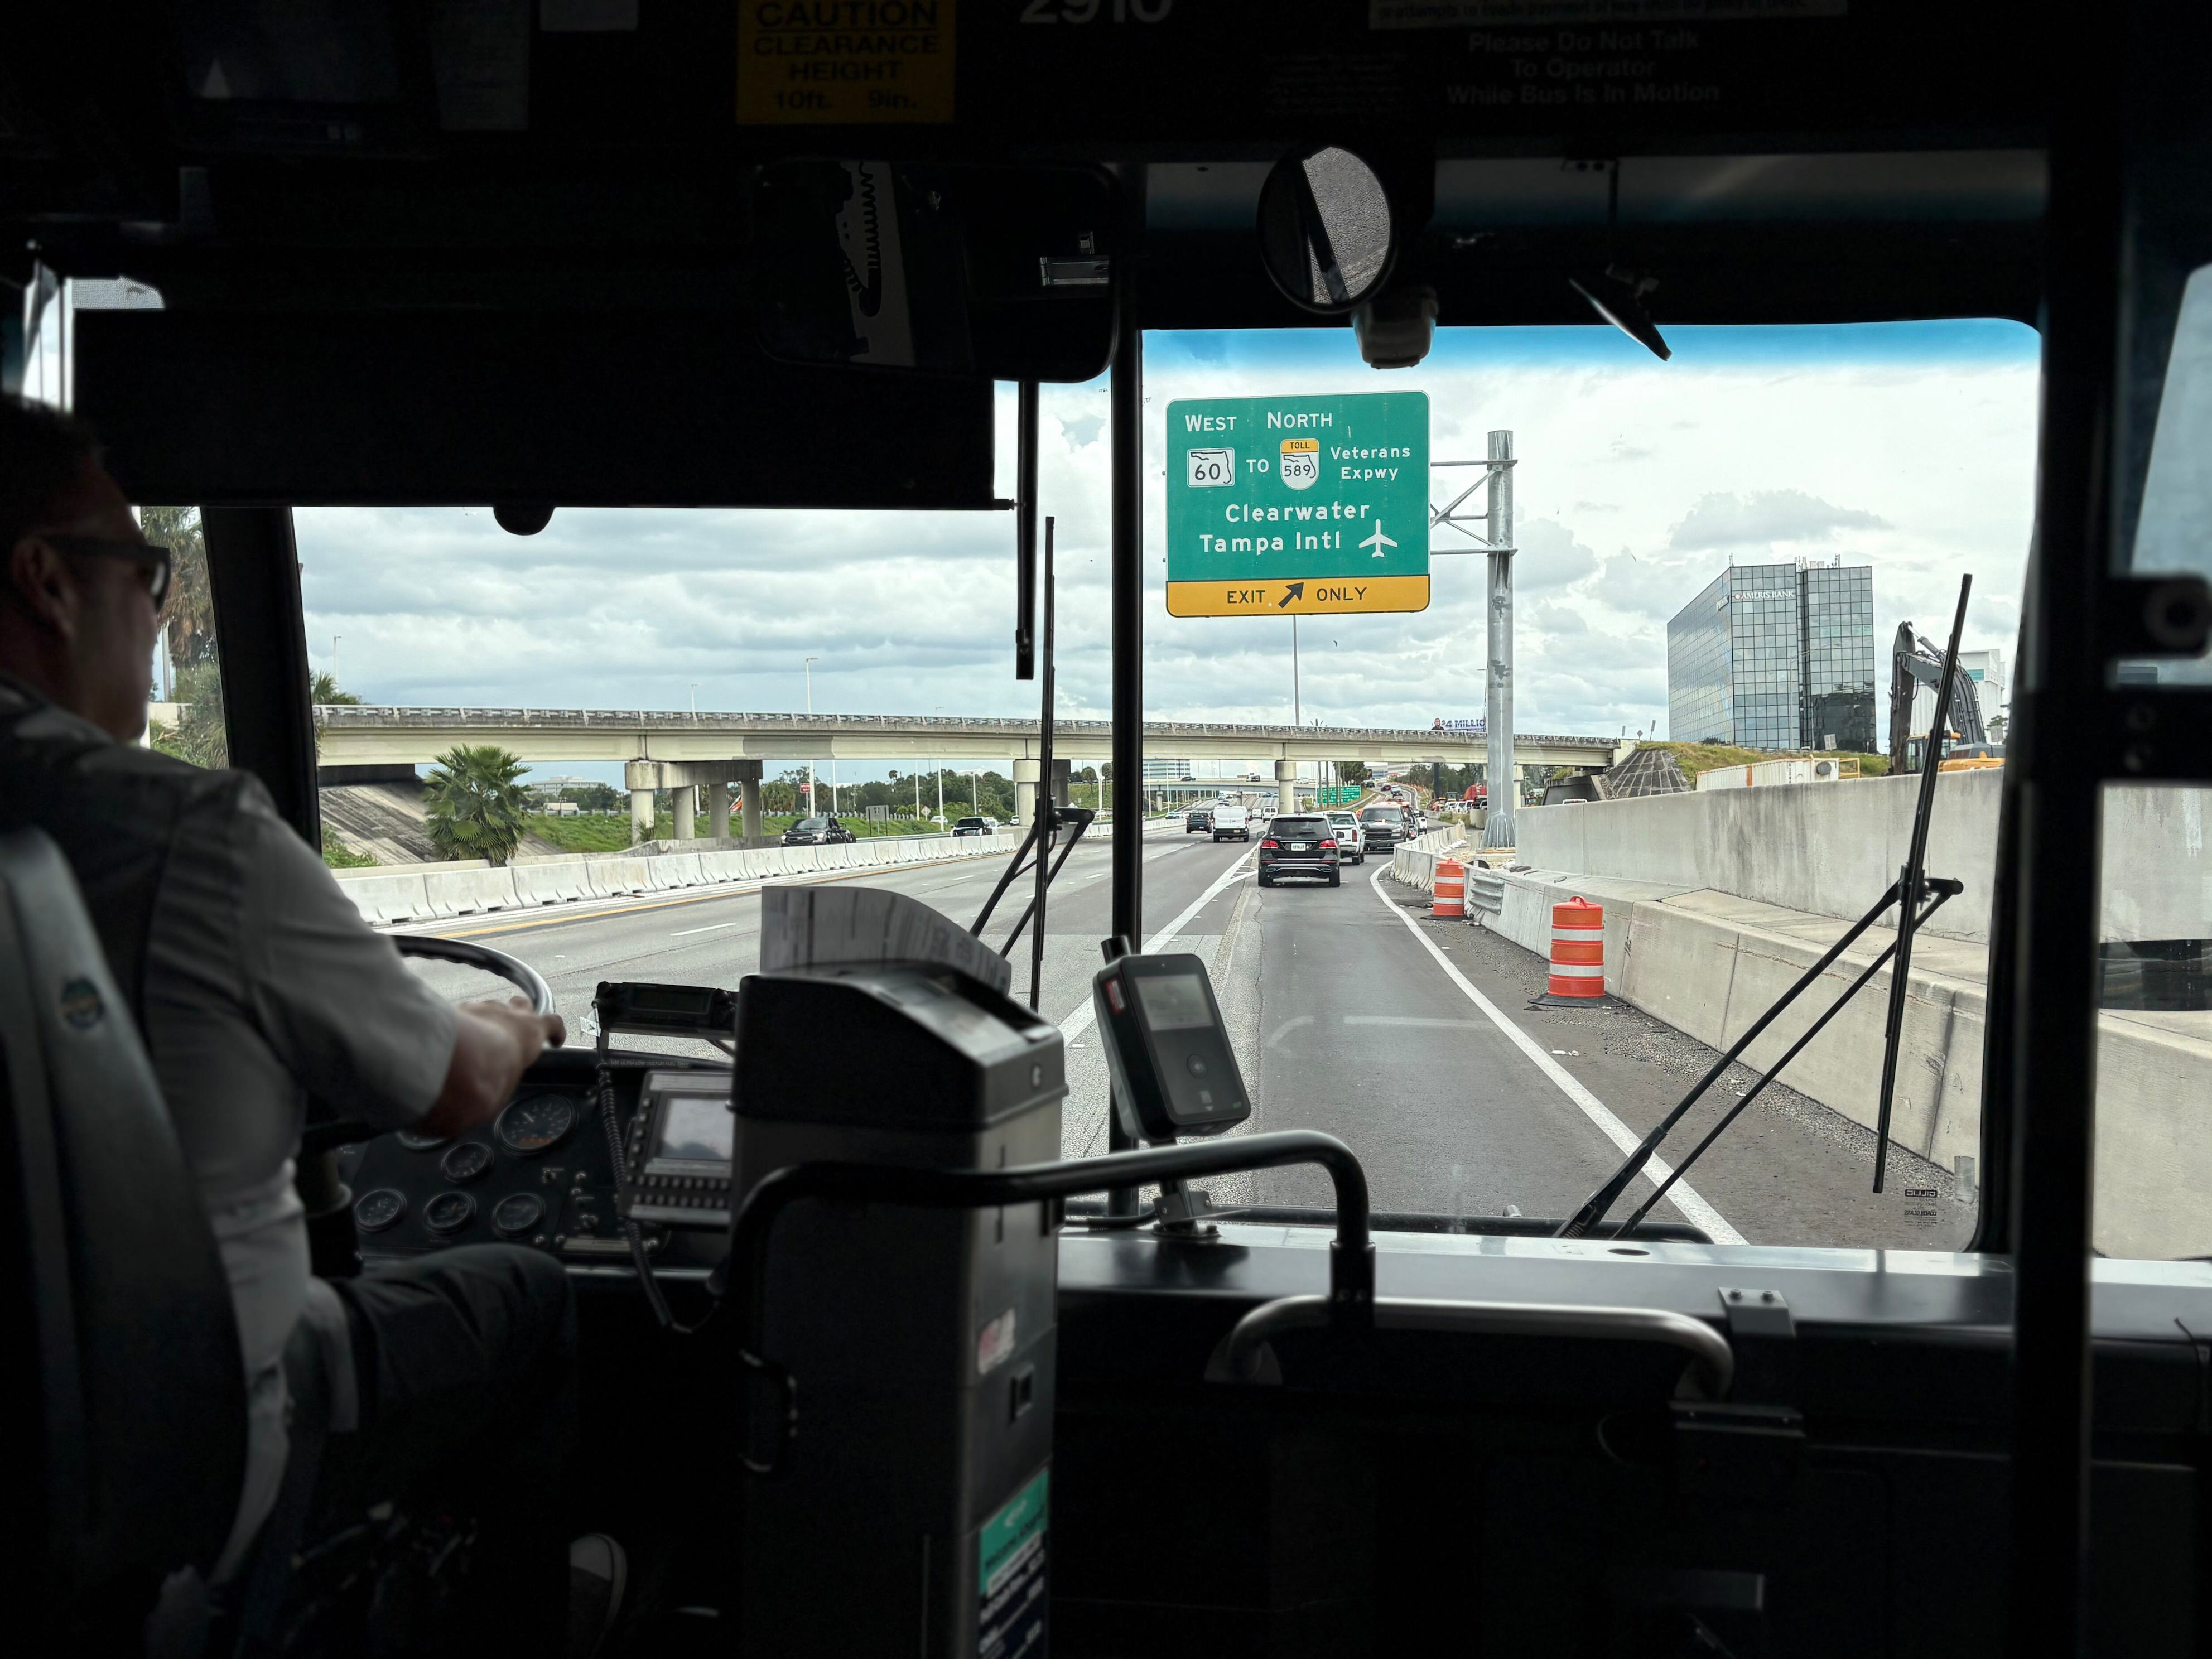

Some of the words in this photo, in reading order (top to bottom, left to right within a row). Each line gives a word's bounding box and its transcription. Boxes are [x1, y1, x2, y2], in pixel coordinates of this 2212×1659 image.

[756, 1, 937, 27] CAUTION
[1464, 5, 1477, 16] to
[754, 35, 939, 55] CLEARANCE
[1468, 32, 1550, 52] Please
[1558, 31, 1591, 51] Do
[1599, 31, 1644, 51] Not
[1651, 30, 1700, 50] Talk
[789, 60, 902, 81] HEIGHT
[1510, 58, 1538, 77] To
[1546, 57, 1657, 80] Operator
[775, 90, 832, 109] 10ft.
[868, 89, 917, 108] 9in.
[1446, 84, 1513, 104] While
[1521, 85, 1567, 104] Bus
[1575, 84, 1596, 102] Is
[1603, 84, 1625, 102] In
[1633, 83, 1721, 102] Motion
[1185, 414, 1237, 432] WEST
[1267, 411, 1333, 429] NORTH
[1290, 441, 1310, 450] TOLL
[1331, 446, 1410, 460] Veterans
[1194, 463, 1221, 481] 60
[1246, 459, 1270, 473] TO
[1284, 464, 1311, 477] 589
[1341, 466, 1399, 481] Expwy
[1226, 501, 1370, 523] Clearwater
[1199, 534, 1283, 556] Tampa
[1296, 531, 1340, 551] Intl
[1227, 590, 1266, 604] EXIT
[1317, 587, 1367, 601] ONLY
[1741, 591, 1770, 600] AMERIS
